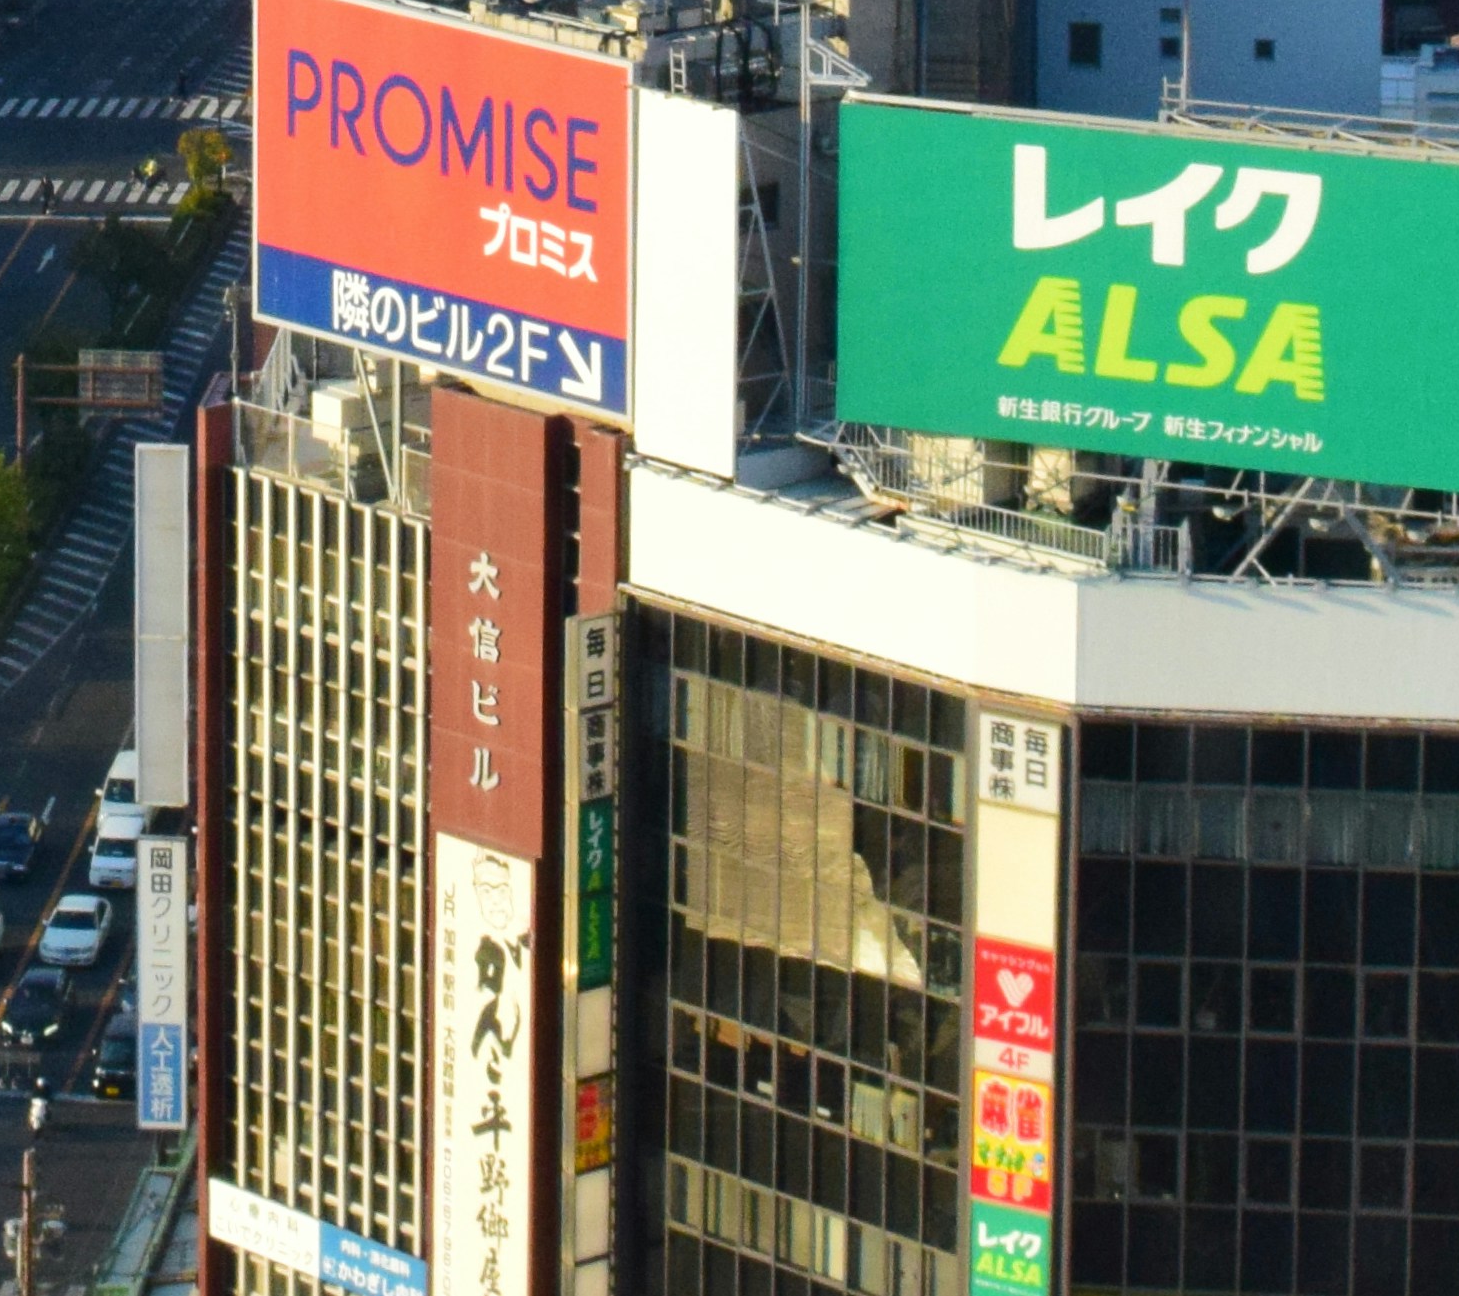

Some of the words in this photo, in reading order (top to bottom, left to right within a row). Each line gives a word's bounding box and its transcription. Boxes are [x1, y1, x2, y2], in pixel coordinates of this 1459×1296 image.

[287, 48, 600, 214] PROMISE
[479, 202, 599, 283] プロミス
[1012, 143, 1323, 275] レイク
[332, 268, 551, 383] 隣のビル2F
[996, 275, 1325, 402] ALSA
[996, 394, 1152, 434] 新生銀行グループ
[1164, 415, 1324, 455] 新生フィナンシャル
[468, 551, 501, 794] 大信ビル
[1024, 726, 1049, 790] 毎日
[586, 811, 606, 870] レイク
[149, 846, 174, 1018] 岡田クリニック
[978, 1004, 1051, 1039] アイフル
[149, 1025, 175, 1121] 人工透析
[998, 1047, 1030, 1071] 4F
[980, 1079, 1044, 1143] 麻雀
[976, 1252, 1043, 1288] ALSA
[977, 1220, 1043, 1259] レイク
